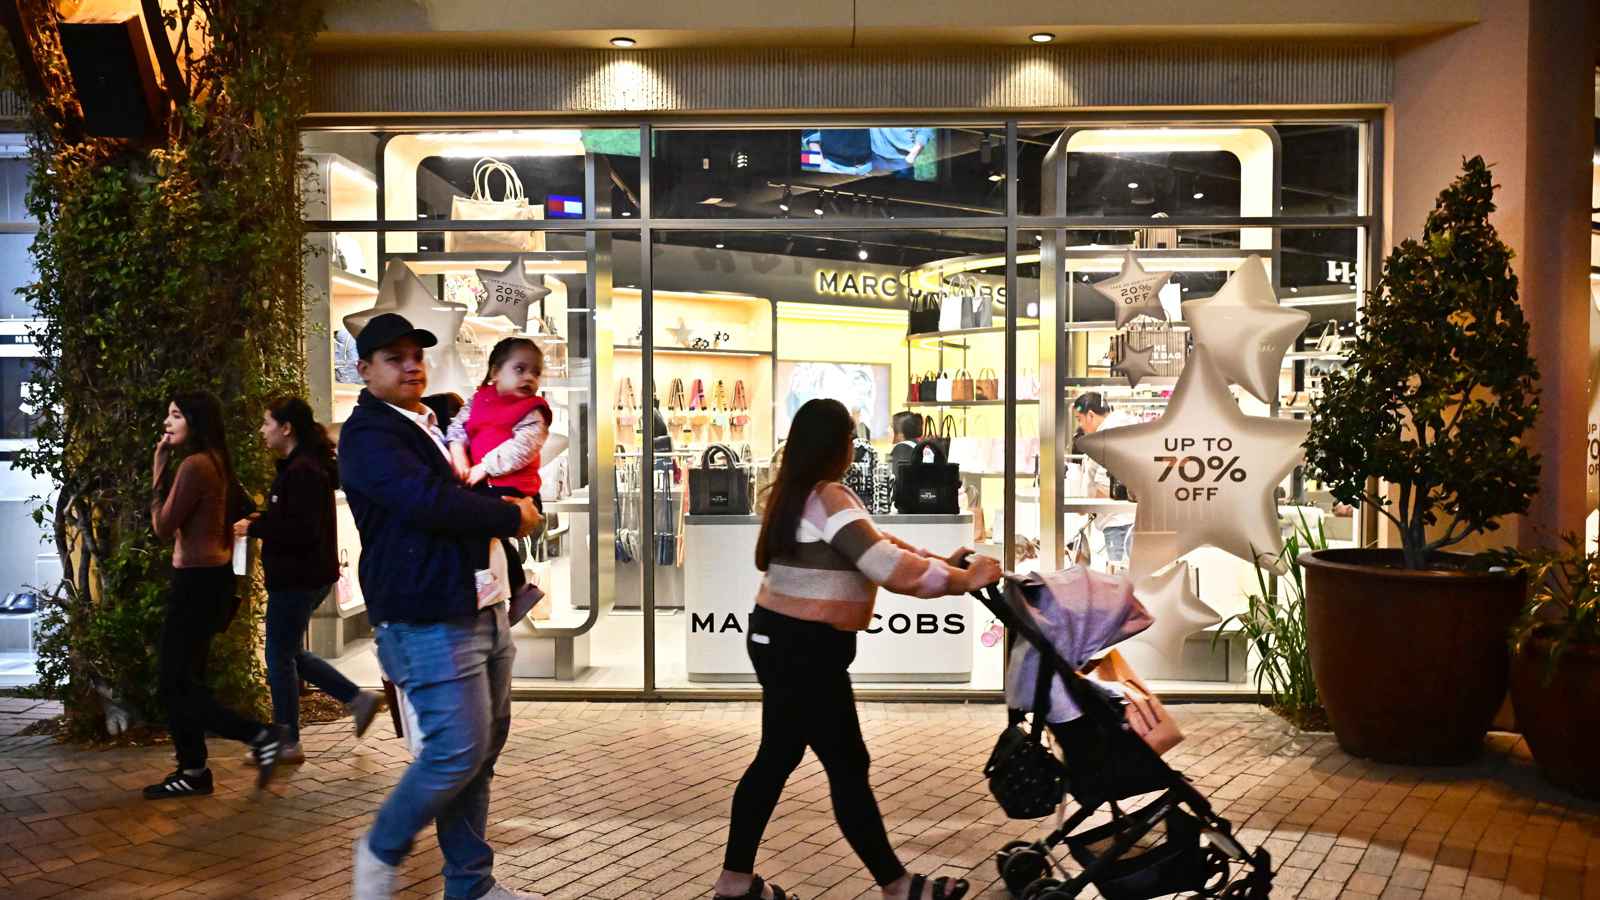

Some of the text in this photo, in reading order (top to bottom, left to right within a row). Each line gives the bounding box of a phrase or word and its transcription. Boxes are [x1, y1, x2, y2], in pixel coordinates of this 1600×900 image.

[819, 271, 897, 297] MARC
[1121, 284, 1151, 297] 20%
[495, 285, 526, 299] 20%
[1125, 292, 1149, 304] OFF
[496, 294, 521, 306] OFF
[1164, 437, 1232, 451] UP TO
[1154, 455, 1247, 482] 70%
[1174, 487, 1218, 501] OFF
[692, 613, 965, 634] MA COBS
